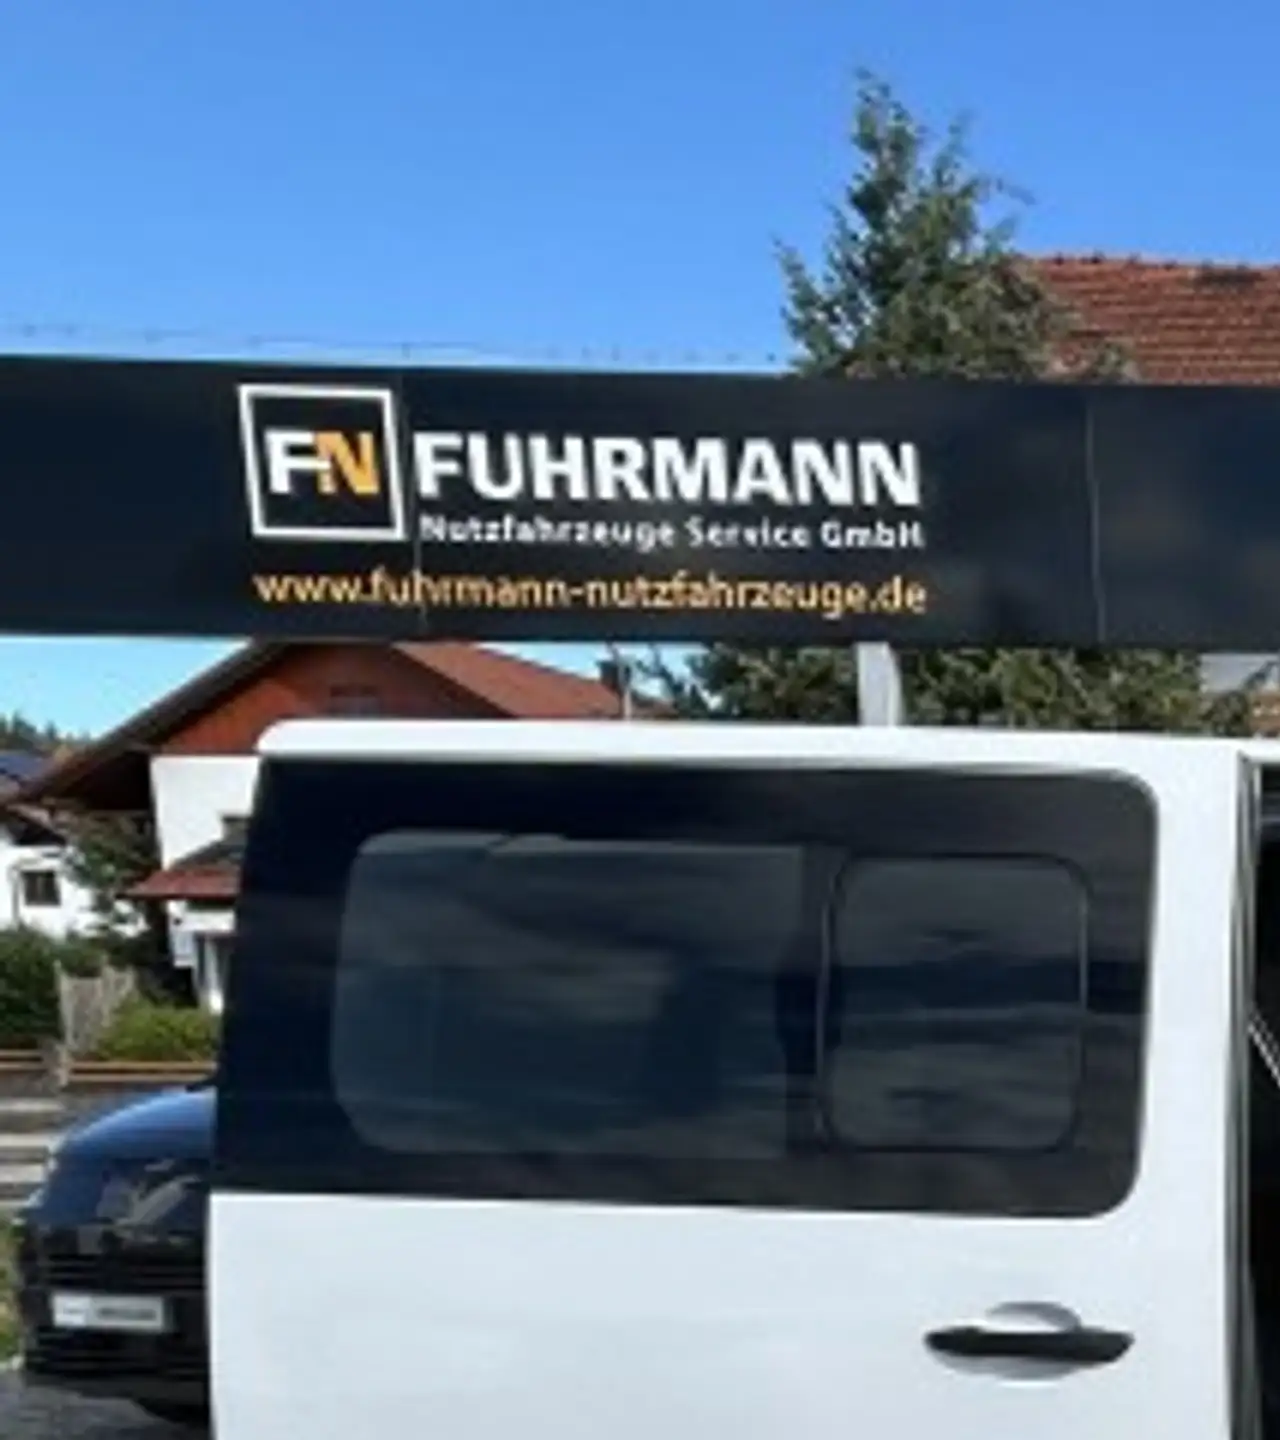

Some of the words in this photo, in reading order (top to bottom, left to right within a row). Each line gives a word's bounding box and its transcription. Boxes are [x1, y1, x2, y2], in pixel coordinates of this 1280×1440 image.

[262, 430, 381, 495] FN
[413, 432, 921, 506] FUHRMANN
[420, 514, 676, 551] Nutzfahrzeuge
[684, 516, 810, 547] Service
[821, 521, 925, 548] GmbH
[254, 566, 926, 619] www.fuhrmann-nutzfahrzeuge.de
